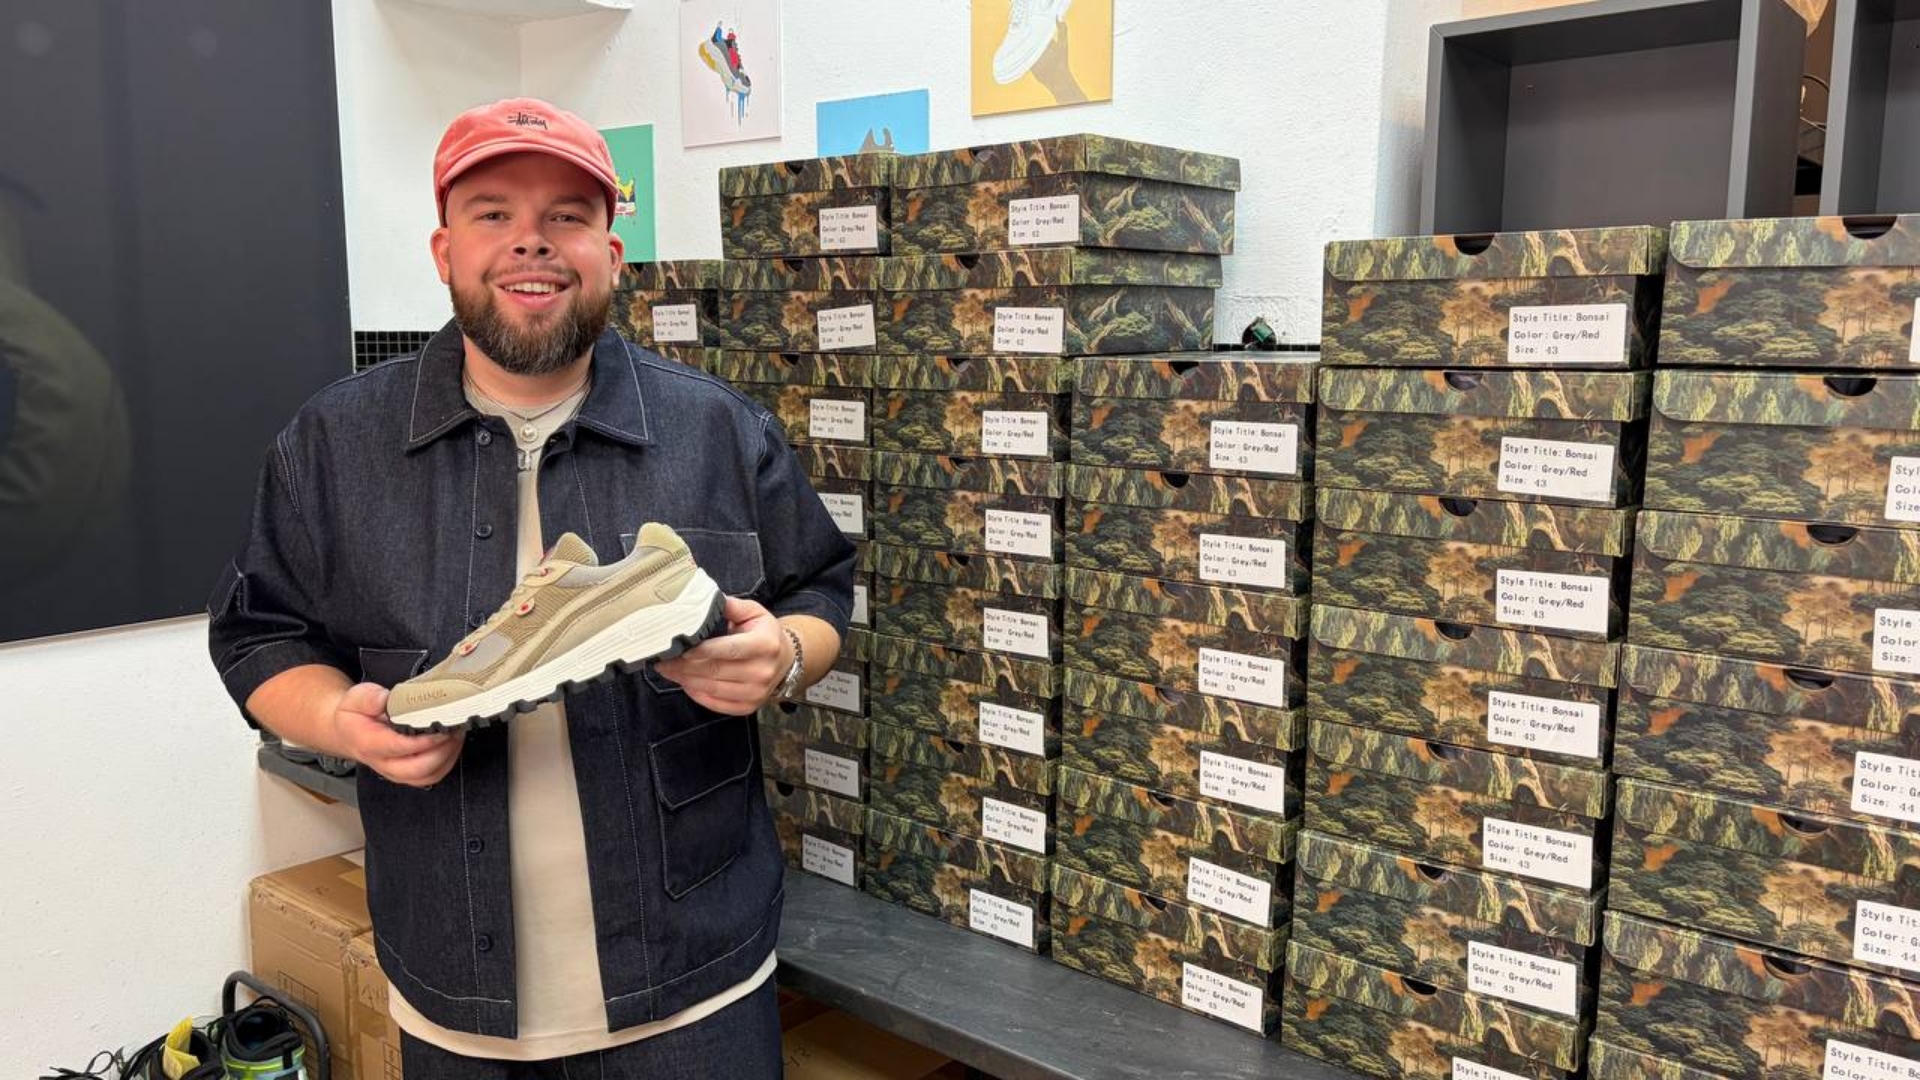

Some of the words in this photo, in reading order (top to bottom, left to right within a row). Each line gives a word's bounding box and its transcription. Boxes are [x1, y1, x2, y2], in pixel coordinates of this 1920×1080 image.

[1513, 313, 1538, 324] Style
[1542, 312, 1572, 325] Title:
[1576, 312, 1609, 322] Bonsai
[1552, 329, 1600, 341] Grey/Red
[1515, 344, 1537, 354] Size:
[1545, 345, 1558, 355] 43
[1213, 425, 1232, 436] Style
[1260, 428, 1285, 438] Bonsai
[1242, 442, 1278, 453] Grey/Red
[1504, 443, 1529, 454] Style
[1533, 445, 1561, 456] Title:
[1565, 448, 1597, 460] Bonsai
[1541, 464, 1587, 477] Grey/Red
[1504, 474, 1526, 484] Size:
[1534, 479, 1547, 487] 43
[1202, 539, 1221, 548] Style
[1248, 543, 1273, 553] Bonsai
[1231, 556, 1266, 567] Grey/Red
[1500, 575, 1524, 586] Style
[1529, 577, 1556, 588] Title:
[1560, 581, 1592, 592] Bonsai
[1538, 596, 1584, 608] Grey/Red
[1503, 605, 1524, 615] Size:
[1532, 610, 1544, 619] 43
[1880, 616, 1912, 629] Style
[1201, 652, 1220, 663] Style
[1247, 660, 1272, 672] Bonsai
[1882, 652, 1911, 664] Size:
[1230, 672, 1265, 685] Grey/Red
[1492, 697, 1516, 708] Style
[1520, 701, 1548, 712] Title:
[1552, 705, 1583, 718] Bonsai
[1494, 726, 1515, 737] Size:
[1523, 732, 1536, 741] 43
[1529, 719, 1575, 733] Grey/Red
[1202, 756, 1221, 767] Style
[1247, 766, 1272, 778] Bonsai
[1860, 759, 1892, 774] Style
[1231, 776, 1266, 791] Grey/Red
[1860, 778, 1903, 795] Color:
[1861, 794, 1889, 808] Size:
[1899, 803, 1915, 813] 44
[1487, 823, 1510, 835] Style
[1514, 828, 1542, 842] Title:
[1545, 835, 1576, 849] Bonsai
[1489, 852, 1510, 864] Size:
[1517, 860, 1530, 869] 43
[1523, 847, 1568, 863] Grey/Red
[1192, 862, 1209, 874] Style
[1235, 878, 1258, 892] Bonsai
[1218, 886, 1252, 904] Grey/Red
[1861, 908, 1892, 923] Style
[1862, 927, 1905, 943] Color:
[1911, 936, 1920, 948] G
[1862, 942, 1891, 956] Size:
[1901, 952, 1917, 963] 44
[1471, 947, 1494, 960] Style
[1499, 953, 1526, 966] Title:
[1529, 961, 1560, 976] Bonsai
[1185, 967, 1203, 980] Style
[1228, 983, 1251, 996] Bonsai
[1474, 976, 1493, 987] Size:
[1502, 984, 1514, 994] 43
[1508, 971, 1553, 990] Grey/Red
[1212, 990, 1245, 1008] Grey/Red
[1830, 1047, 1861, 1063] Style
[1868, 1056, 1904, 1075] Title:
